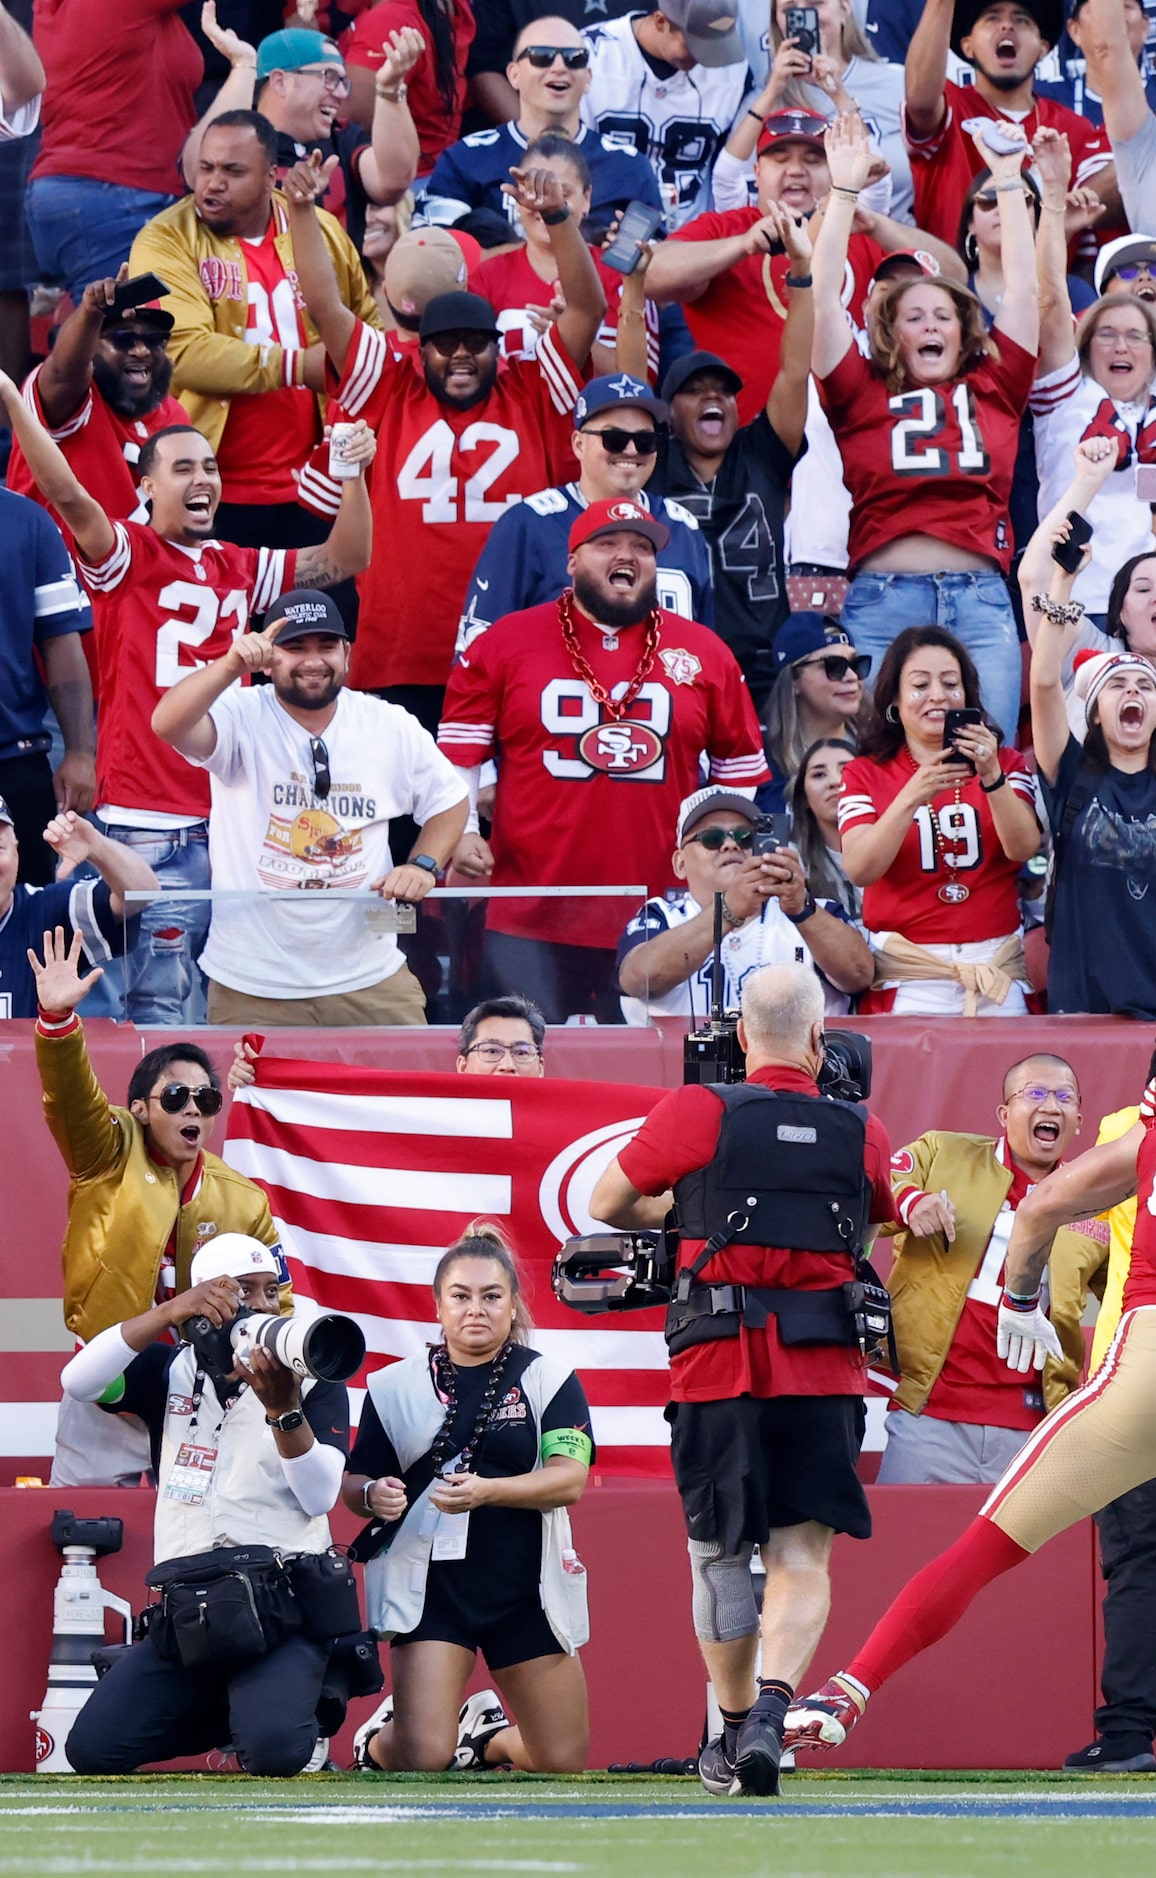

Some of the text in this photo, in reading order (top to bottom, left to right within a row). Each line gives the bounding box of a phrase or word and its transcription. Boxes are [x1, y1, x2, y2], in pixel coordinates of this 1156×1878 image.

[889, 383, 987, 473] 21
[397, 419, 523, 524] 42
[284, 603, 327, 616] WATERLOO
[670, 656, 692, 675] 75
[541, 679, 671, 783] 92
[597, 727, 648, 768] SF
[914, 803, 981, 871] 19
